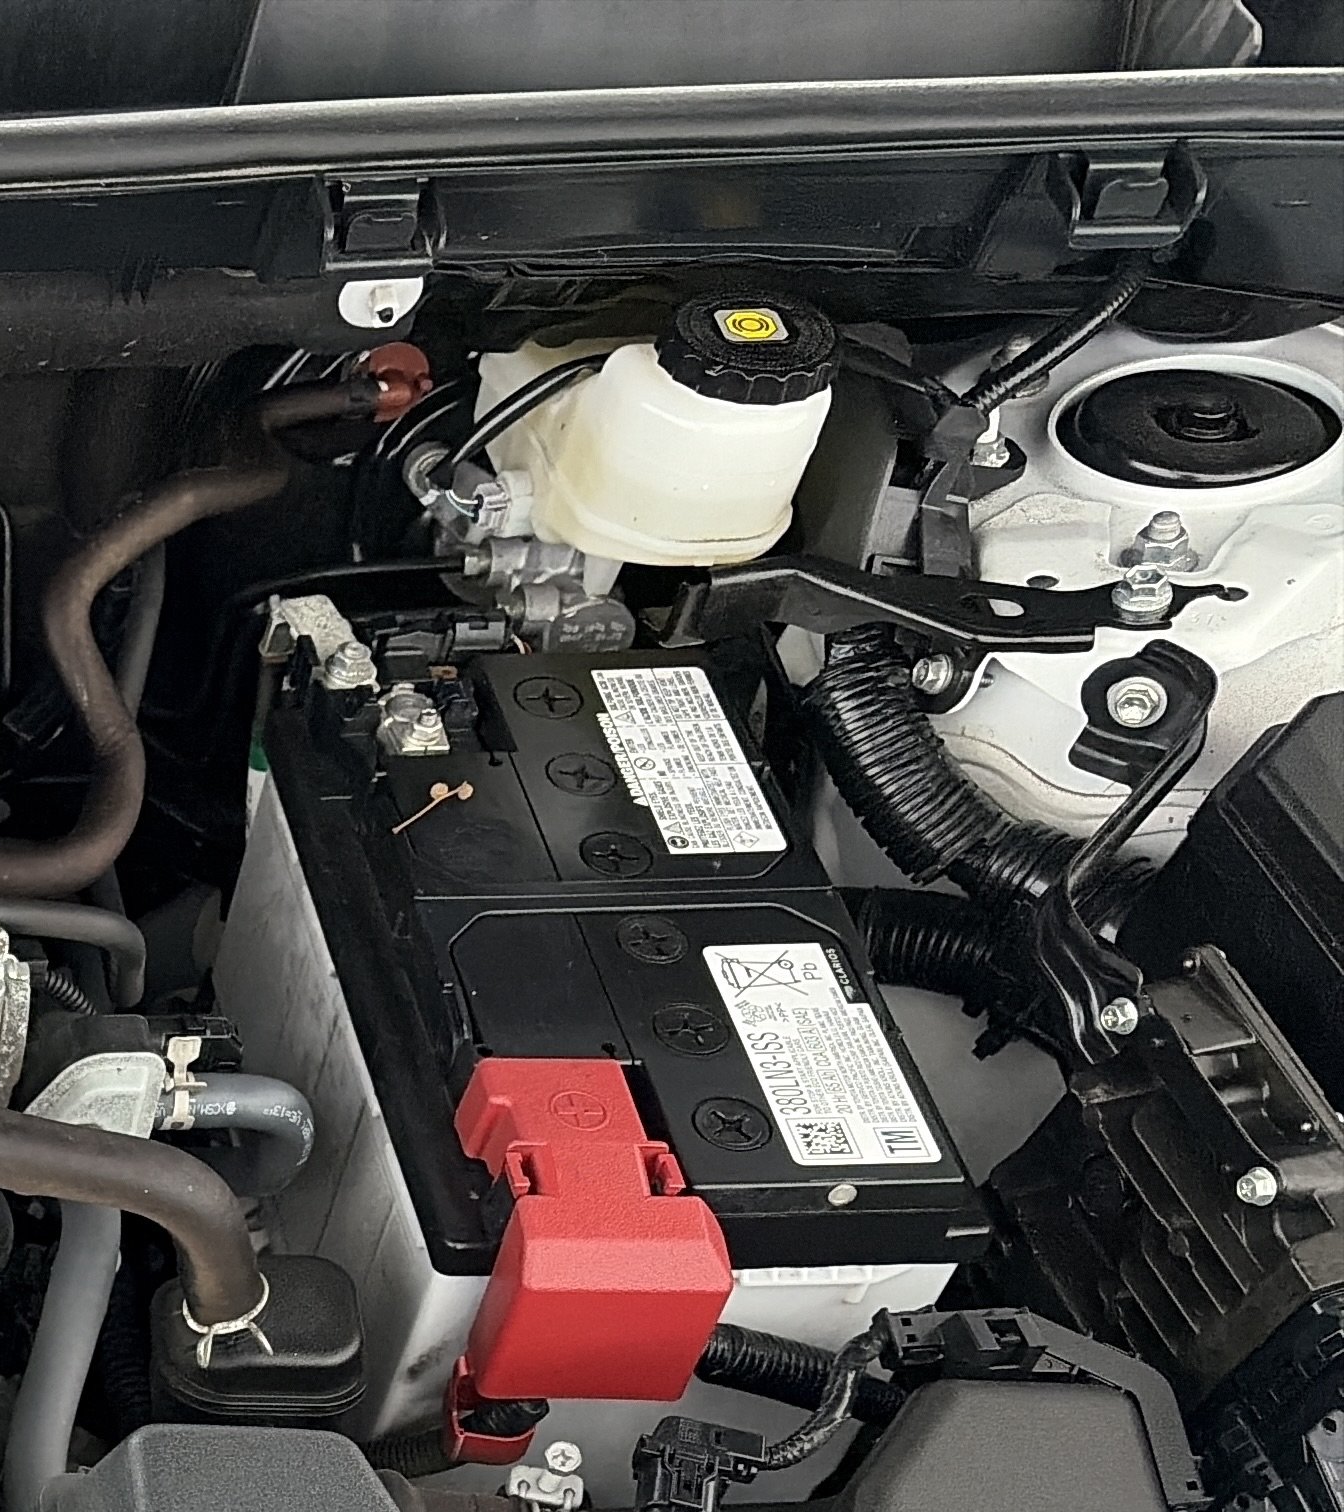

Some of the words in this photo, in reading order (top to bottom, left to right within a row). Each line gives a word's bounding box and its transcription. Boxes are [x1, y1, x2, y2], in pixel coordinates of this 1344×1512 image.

[595, 713, 646, 799] DANGER/POISON
[800, 962, 823, 980] Pb
[825, 948, 850, 986] CLARIOS
[746, 1032, 812, 1115] 380LN3-ISS
[880, 1130, 922, 1154] TM
